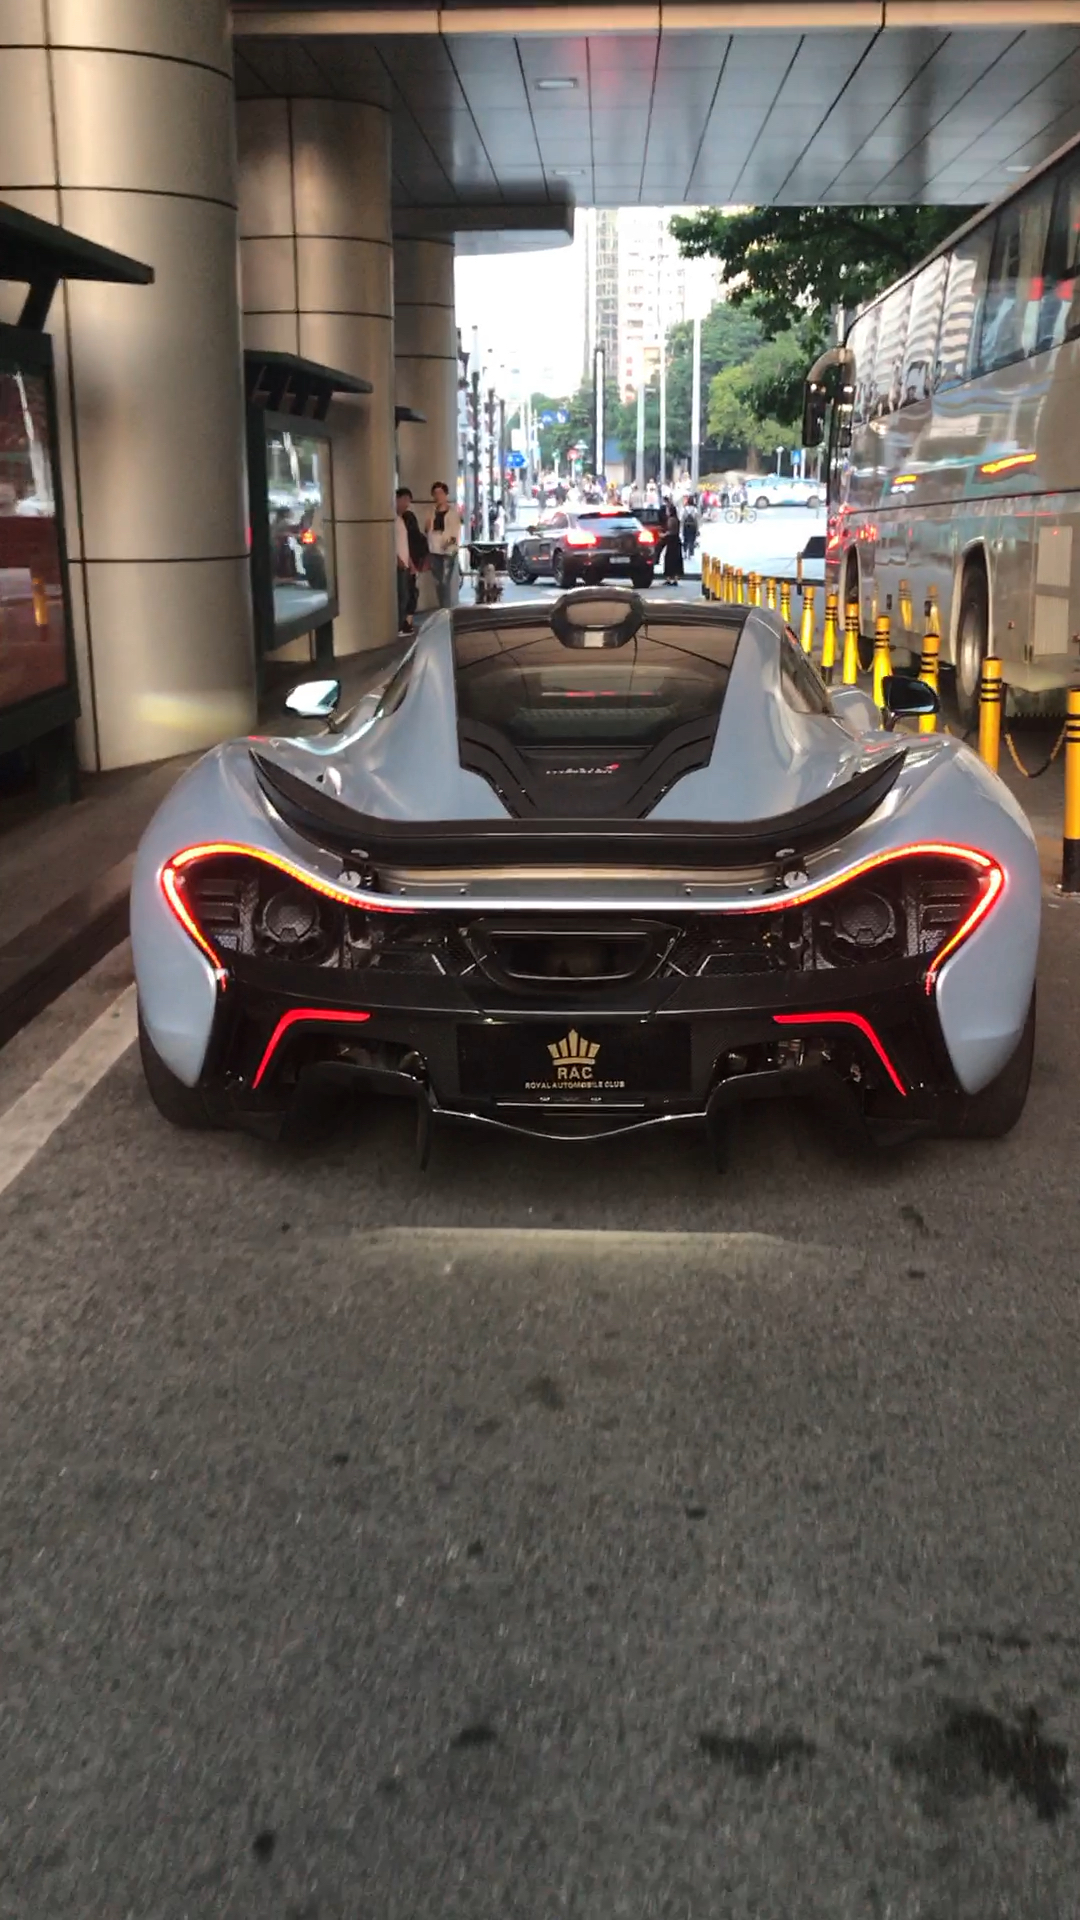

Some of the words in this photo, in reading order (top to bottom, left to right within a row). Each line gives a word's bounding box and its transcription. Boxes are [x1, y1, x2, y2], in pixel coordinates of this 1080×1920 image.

[557, 1066, 593, 1080] RAC
[525, 1081, 550, 1089] ROYAL
[551, 1081, 603, 1089] AUTOMOBILE
[604, 1080, 625, 1088] CLUB
